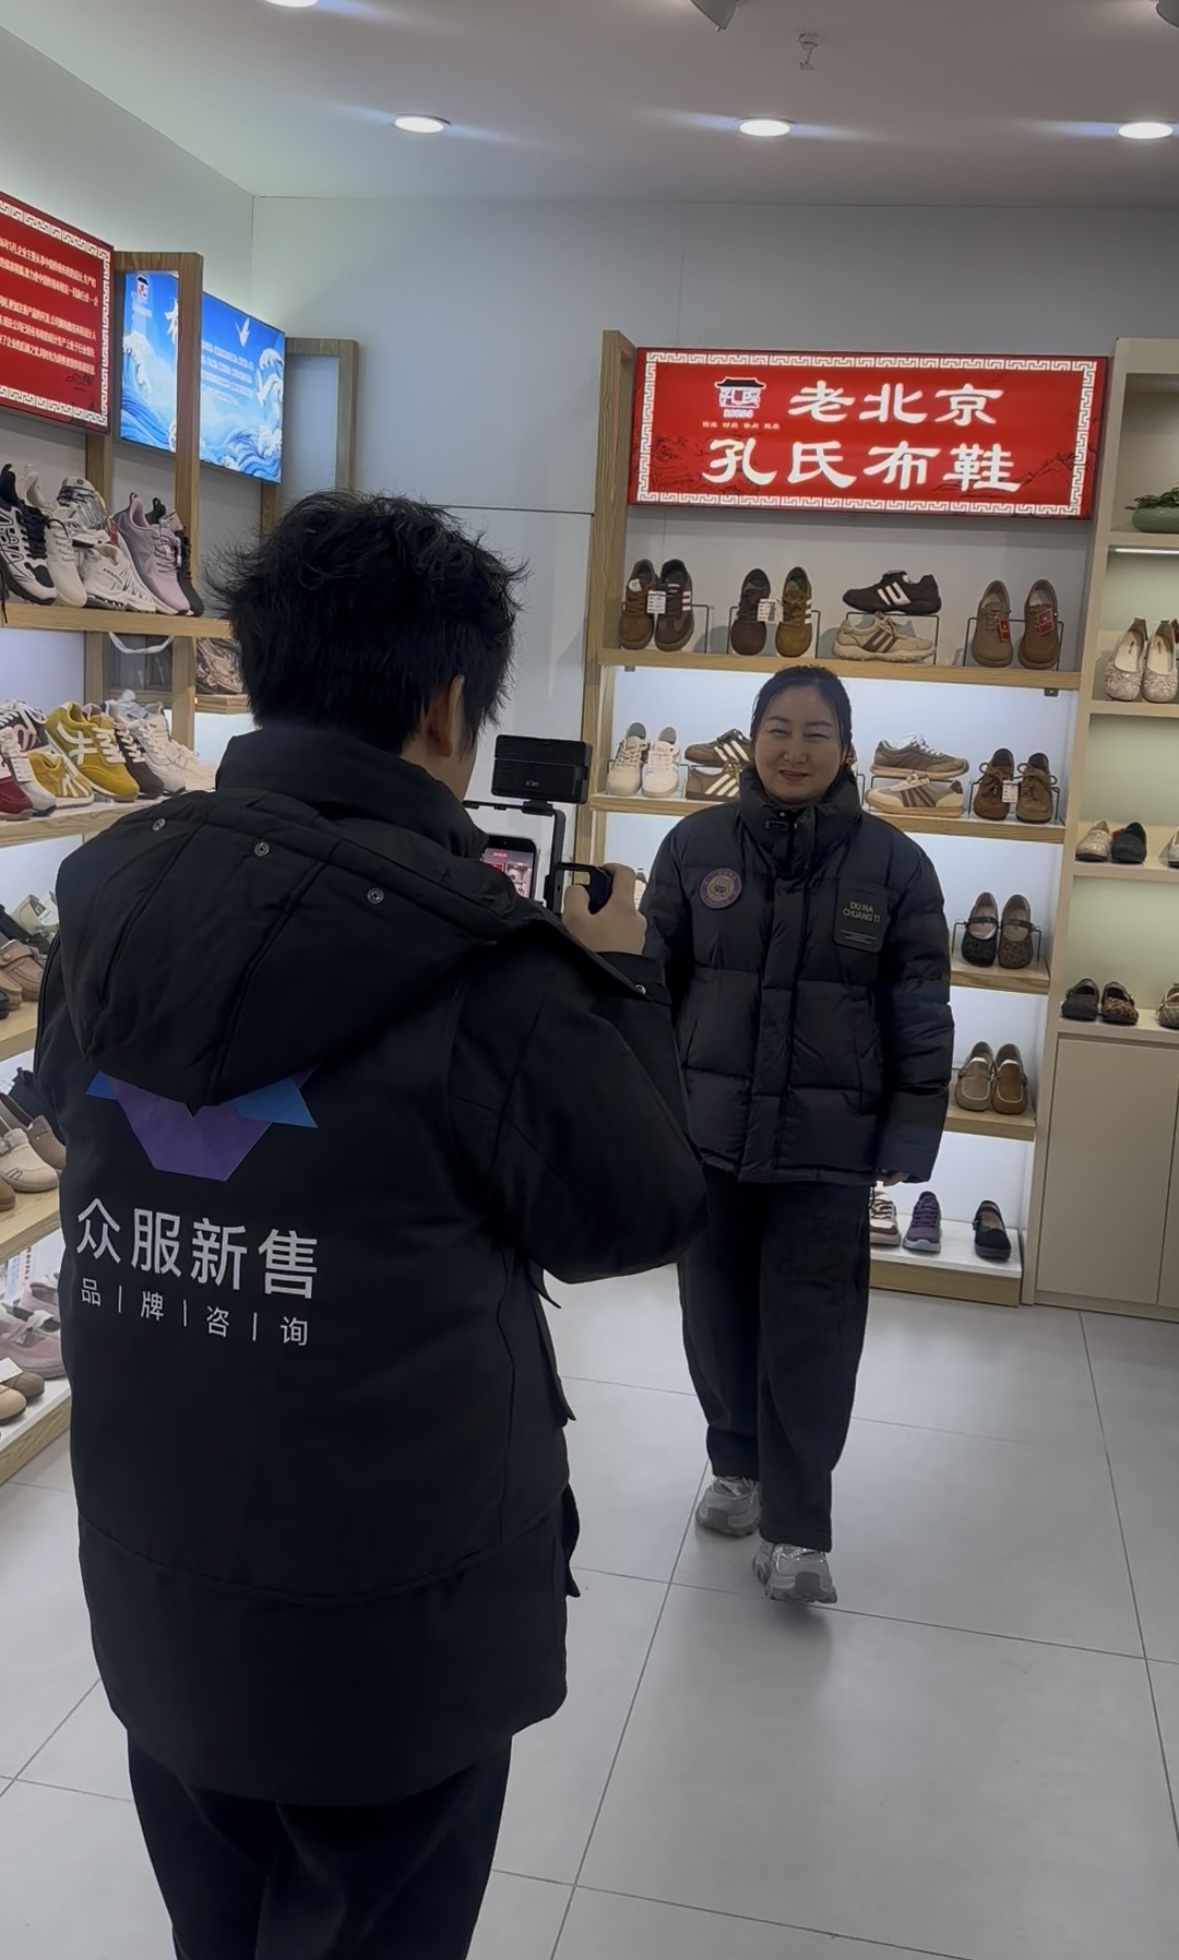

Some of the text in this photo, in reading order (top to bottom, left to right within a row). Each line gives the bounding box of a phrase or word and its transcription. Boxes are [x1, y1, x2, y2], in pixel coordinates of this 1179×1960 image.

[788, 380, 1003, 426] 老北京
[702, 437, 1021, 492] 孔氏布鞋
[77, 1198, 318, 1299] 众服新售
